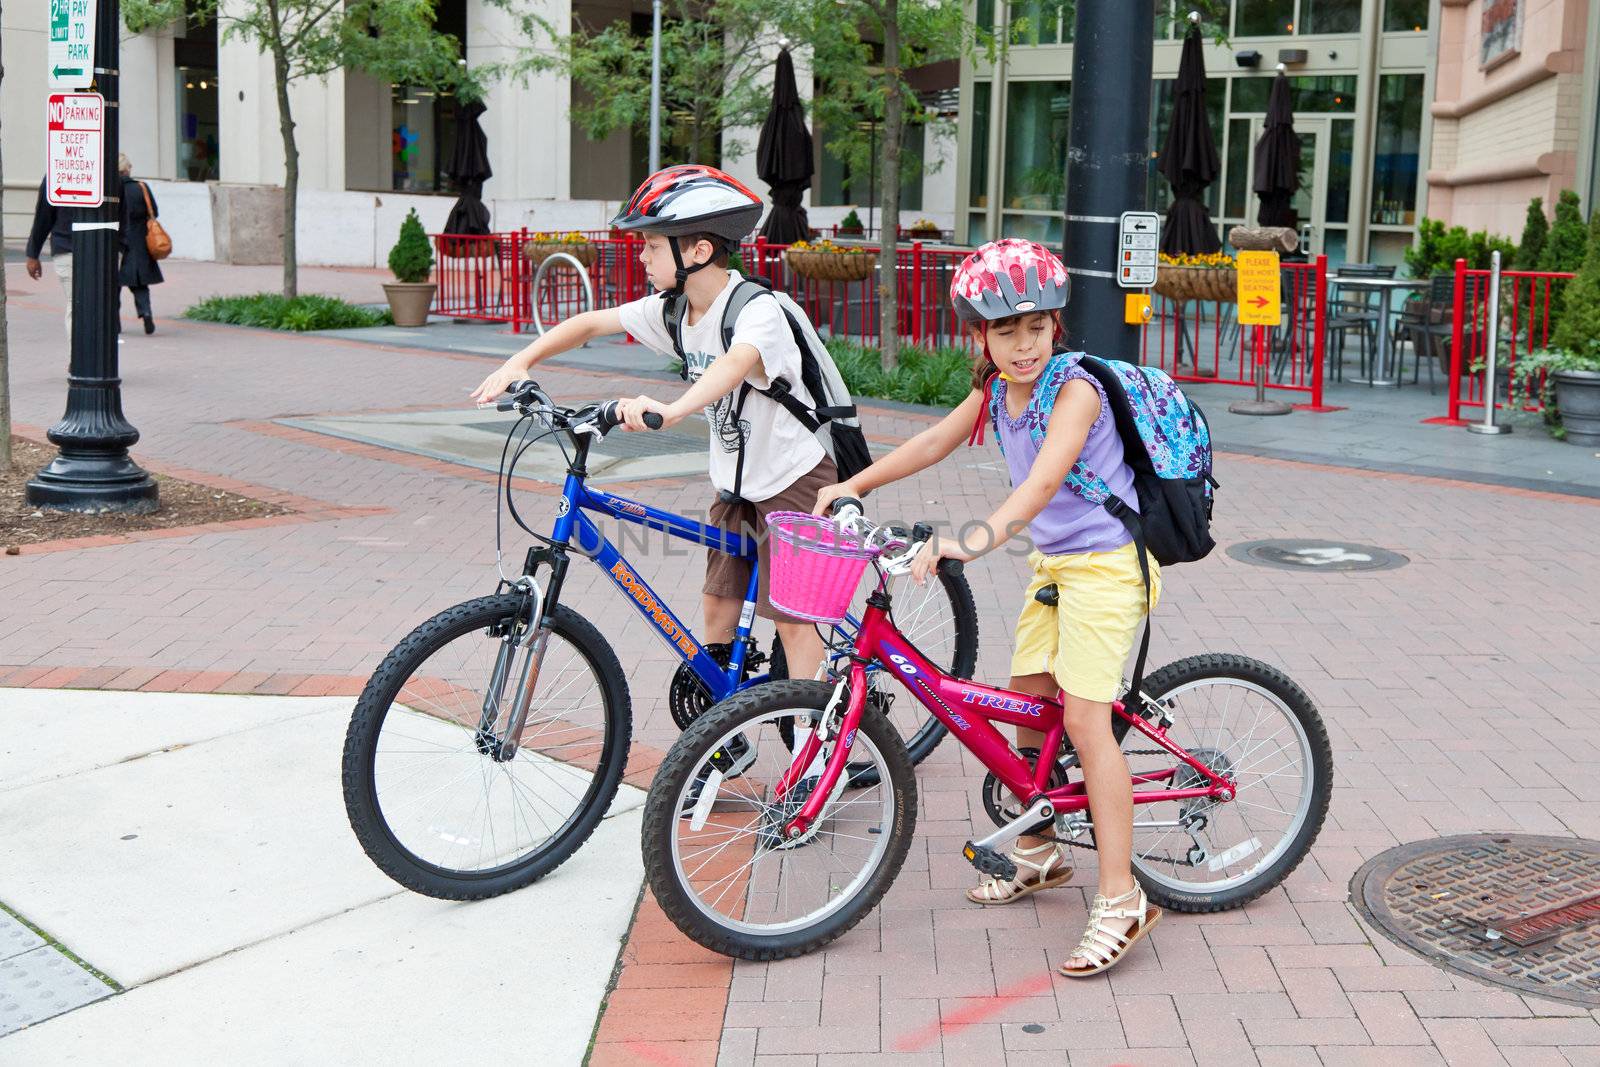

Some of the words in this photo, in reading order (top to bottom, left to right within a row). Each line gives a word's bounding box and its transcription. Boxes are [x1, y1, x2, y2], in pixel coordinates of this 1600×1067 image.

[52, 0, 59, 21] 2
[72, 1, 88, 17] PAY
[52, 27, 68, 38] LIMIT
[75, 23, 84, 39] TO
[68, 43, 89, 60] PARK
[49, 102, 63, 123] NO
[65, 107, 99, 121] PARKING
[60, 133, 89, 144] EXCEPT
[65, 147, 84, 158] MVC
[55, 159, 95, 171] THURSDAY
[56, 172, 93, 184] 2PM-6PM
[1246, 258, 1271, 267] PLEASE
[611, 560, 699, 661] ROADMASTER
[889, 654, 917, 674] 60
[962, 689, 1044, 717] TREK
